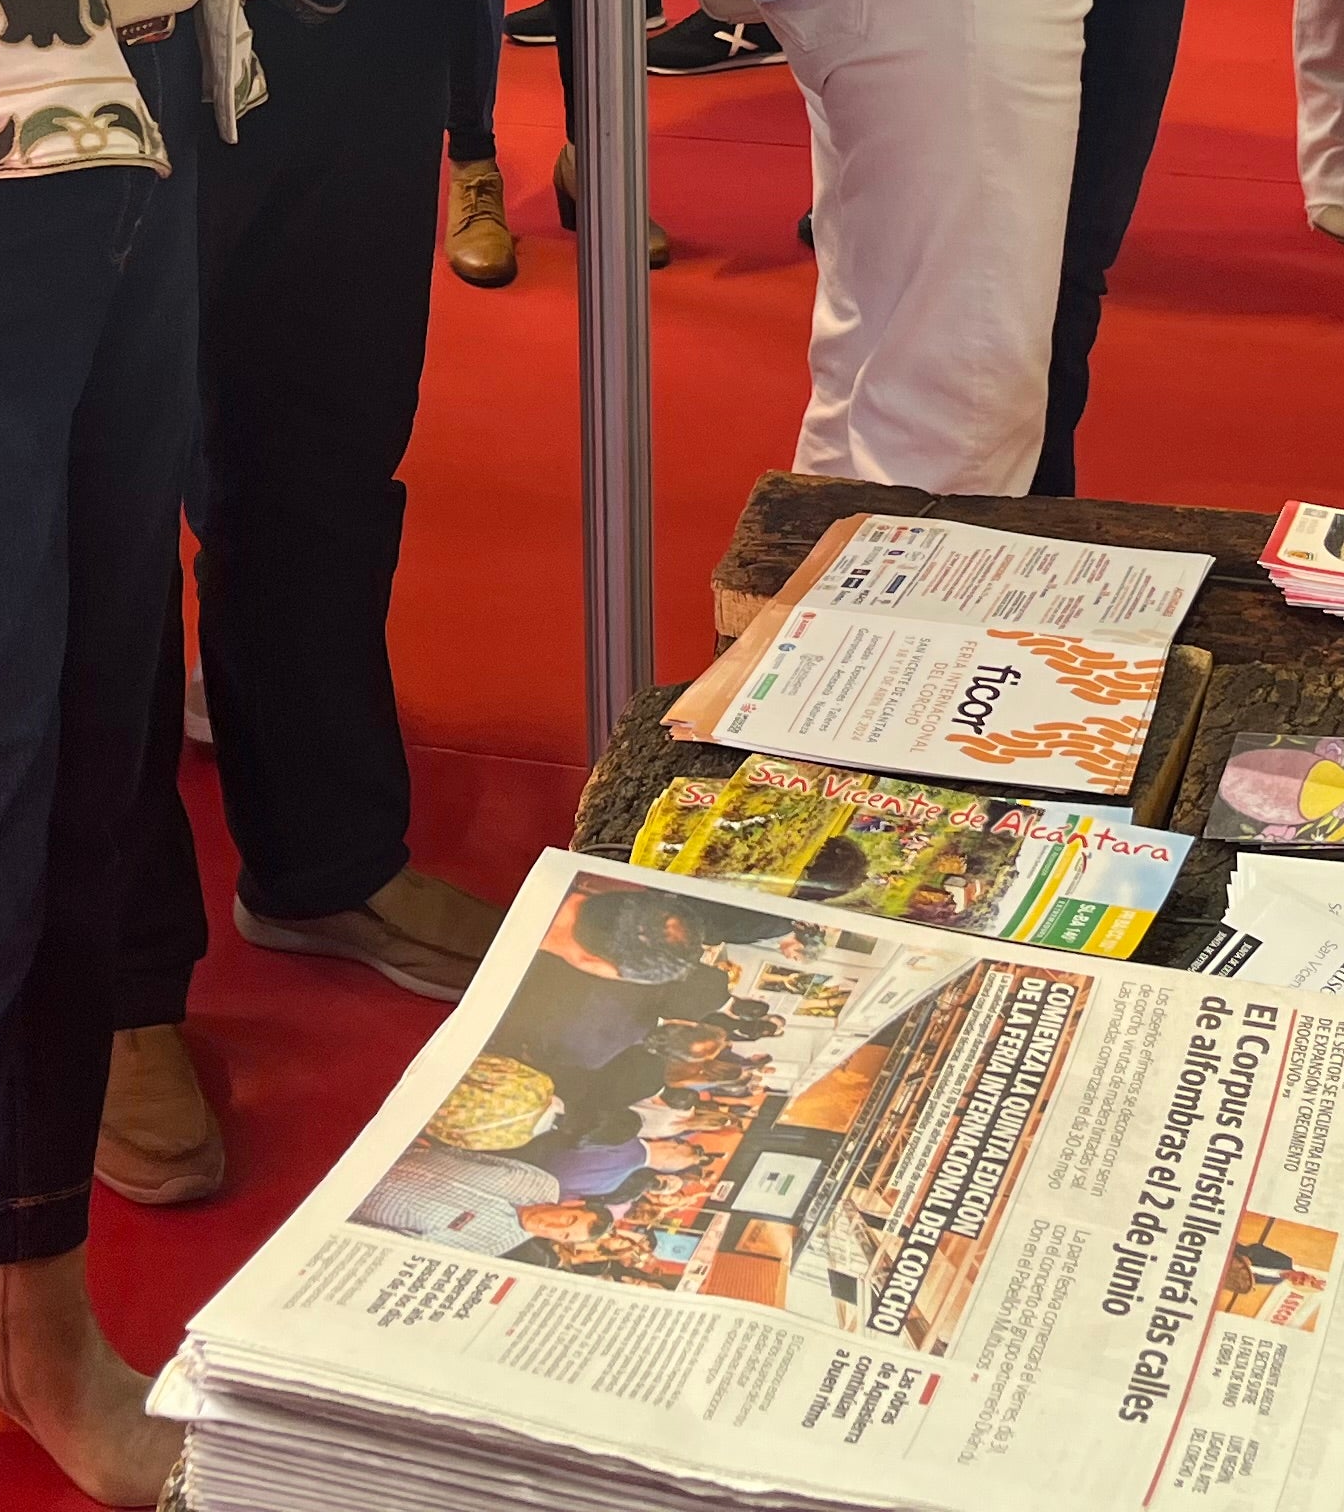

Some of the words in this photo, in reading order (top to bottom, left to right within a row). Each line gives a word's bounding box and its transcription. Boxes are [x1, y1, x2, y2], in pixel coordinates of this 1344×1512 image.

[915, 637, 932, 654] SAN
[953, 640, 978, 669] FERIA
[897, 655, 923, 686] VICENTE
[927, 662, 949, 681] DEL
[891, 686, 906, 697] DE
[904, 683, 937, 726] CORCHO
[952, 664, 1021, 735] ficor
[867, 698, 898, 743] ALCÁNTARA
[910, 672, 962, 752] INTERNACIONAL
[748, 761, 810, 794] San
[821, 773, 941, 823] Vicente
[948, 795, 986, 831] de
[997, 810, 1170, 862] Alcántara
[1317, 940, 1338, 960] San
[1017, 977, 1046, 1002] DE
[1118, 981, 1137, 999] Las
[1138, 984, 1154, 999] de
[1155, 987, 1175, 1007] Los
[1007, 1002, 1037, 1025] LA
[1021, 983, 1074, 1072] COMIENZA
[1103, 999, 1127, 1045] jornadas
[1125, 999, 1148, 1036] corcho,
[1142, 1008, 1166, 1048] diseños
[1196, 996, 1234, 1030] de
[1242, 1003, 1278, 1031] El
[1316, 1017, 1334, 1033] DE
[986, 1026, 1026, 1074] FERIA
[1113, 1039, 1135, 1075] virutas
[1286, 1015, 1314, 1087] PROGRESIVO»
[1303, 1034, 1330, 1096] EXPANSIÓN
[1010, 1073, 1039, 1095] LA
[1082, 1045, 1112, 1105] comenzarán
[1108, 1075, 1125, 1090] de
[1127, 1049, 1153, 1095] efímeros
[1216, 1035, 1269, 1128] Corpus
[1095, 1089, 1118, 1126] madera
[1122, 1094, 1138, 1108] se
[1156, 1036, 1220, 1162] alfombras
[1301, 1097, 1316, 1106] Y
[1322, 1084, 1339, 1098] SE
[1071, 1115, 1090, 1131] día
[1078, 1105, 1093, 1117] el
[1109, 1108, 1133, 1148] decoran
[926, 1075, 1005, 1208] INTERNACIONAL
[983, 1097, 1028, 1160] QUINTA
[1065, 1131, 1084, 1148] 30
[1284, 1105, 1313, 1172] CRECIMIENTO
[1308, 1099, 1335, 1159] ENCUENTRA
[1059, 1147, 1078, 1162] de
[1079, 1126, 1106, 1167] tintadas
[1102, 1148, 1119, 1168] con
[1047, 1161, 1069, 1190] mayo
[1073, 1164, 1089, 1175] y
[1090, 1168, 1111, 1198] serrín
[1145, 1166, 1181, 1192] el
[1190, 1133, 1243, 1215] Christi
[1303, 1160, 1320, 1176] EN
[951, 1161, 1003, 1236] EDICIÓN
[1138, 1191, 1175, 1210] 2
[1293, 1175, 1317, 1214] ESTADO
[908, 1211, 945, 1245] DEL
[1126, 1212, 1167, 1246] de
[1160, 1215, 1221, 1304] llenará
[873, 1248, 928, 1332] CORCHO
[1102, 1243, 1157, 1316] junio
[1146, 1306, 1193, 1346] las
[835, 1349, 850, 1359] a
[877, 1362, 899, 1380] de
[819, 1359, 850, 1394] buen
[832, 1356, 872, 1419] continúan
[898, 1367, 922, 1390] Las
[1119, 1350, 1170, 1423] calles
[801, 1394, 831, 1429] ritmo
[881, 1391, 909, 1425] obras
